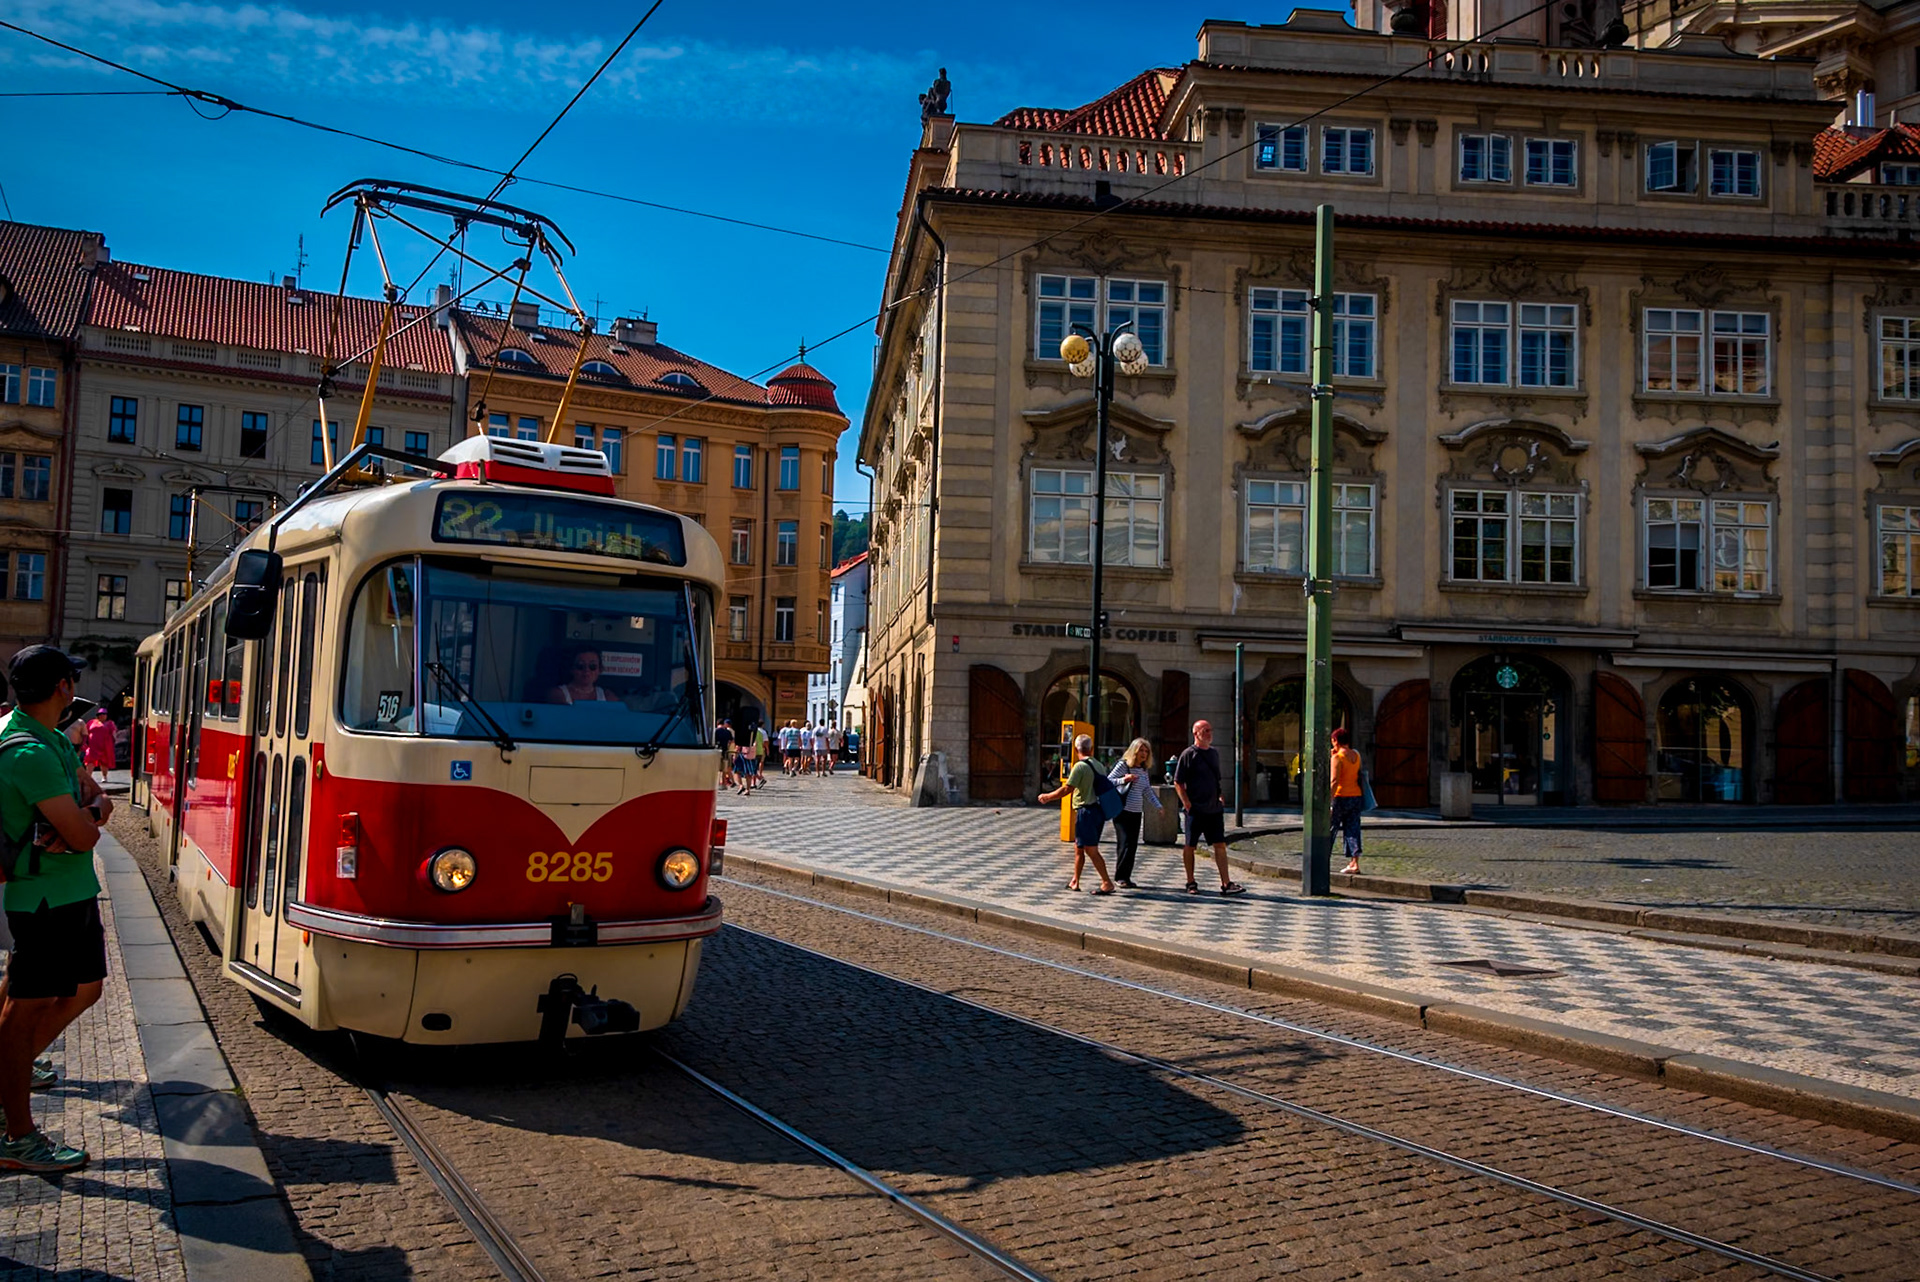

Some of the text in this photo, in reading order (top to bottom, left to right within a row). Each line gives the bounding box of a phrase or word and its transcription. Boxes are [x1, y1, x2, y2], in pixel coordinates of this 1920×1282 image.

[442, 497, 503, 542] 22
[1013, 624, 1177, 642] STARBS COFFEE
[377, 694, 400, 719] 516
[525, 851, 613, 883] 8285
